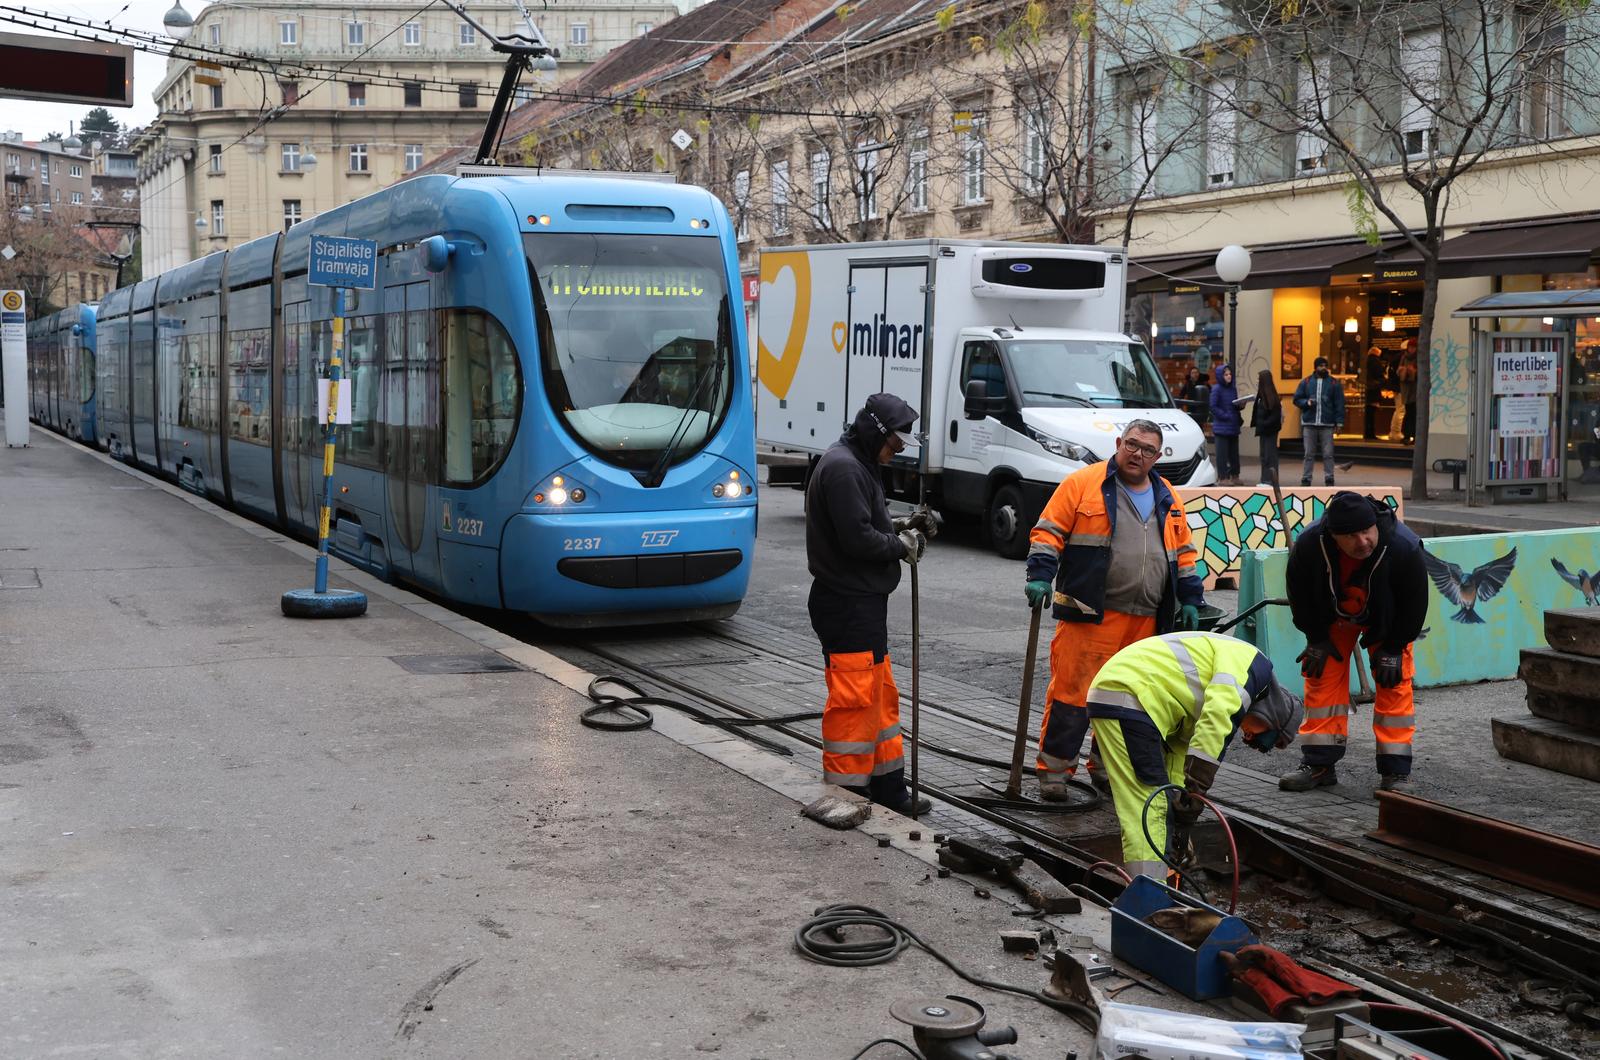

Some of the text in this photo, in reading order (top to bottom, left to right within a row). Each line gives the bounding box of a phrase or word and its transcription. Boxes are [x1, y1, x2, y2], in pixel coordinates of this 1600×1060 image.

[316, 259, 369, 278] tramvaja
[8, 296, 18, 307] S
[853, 313, 923, 360] mlinar
[1497, 356, 1553, 372] Interliber
[457, 518, 483, 536] 2237
[564, 538, 601, 550] 2237
